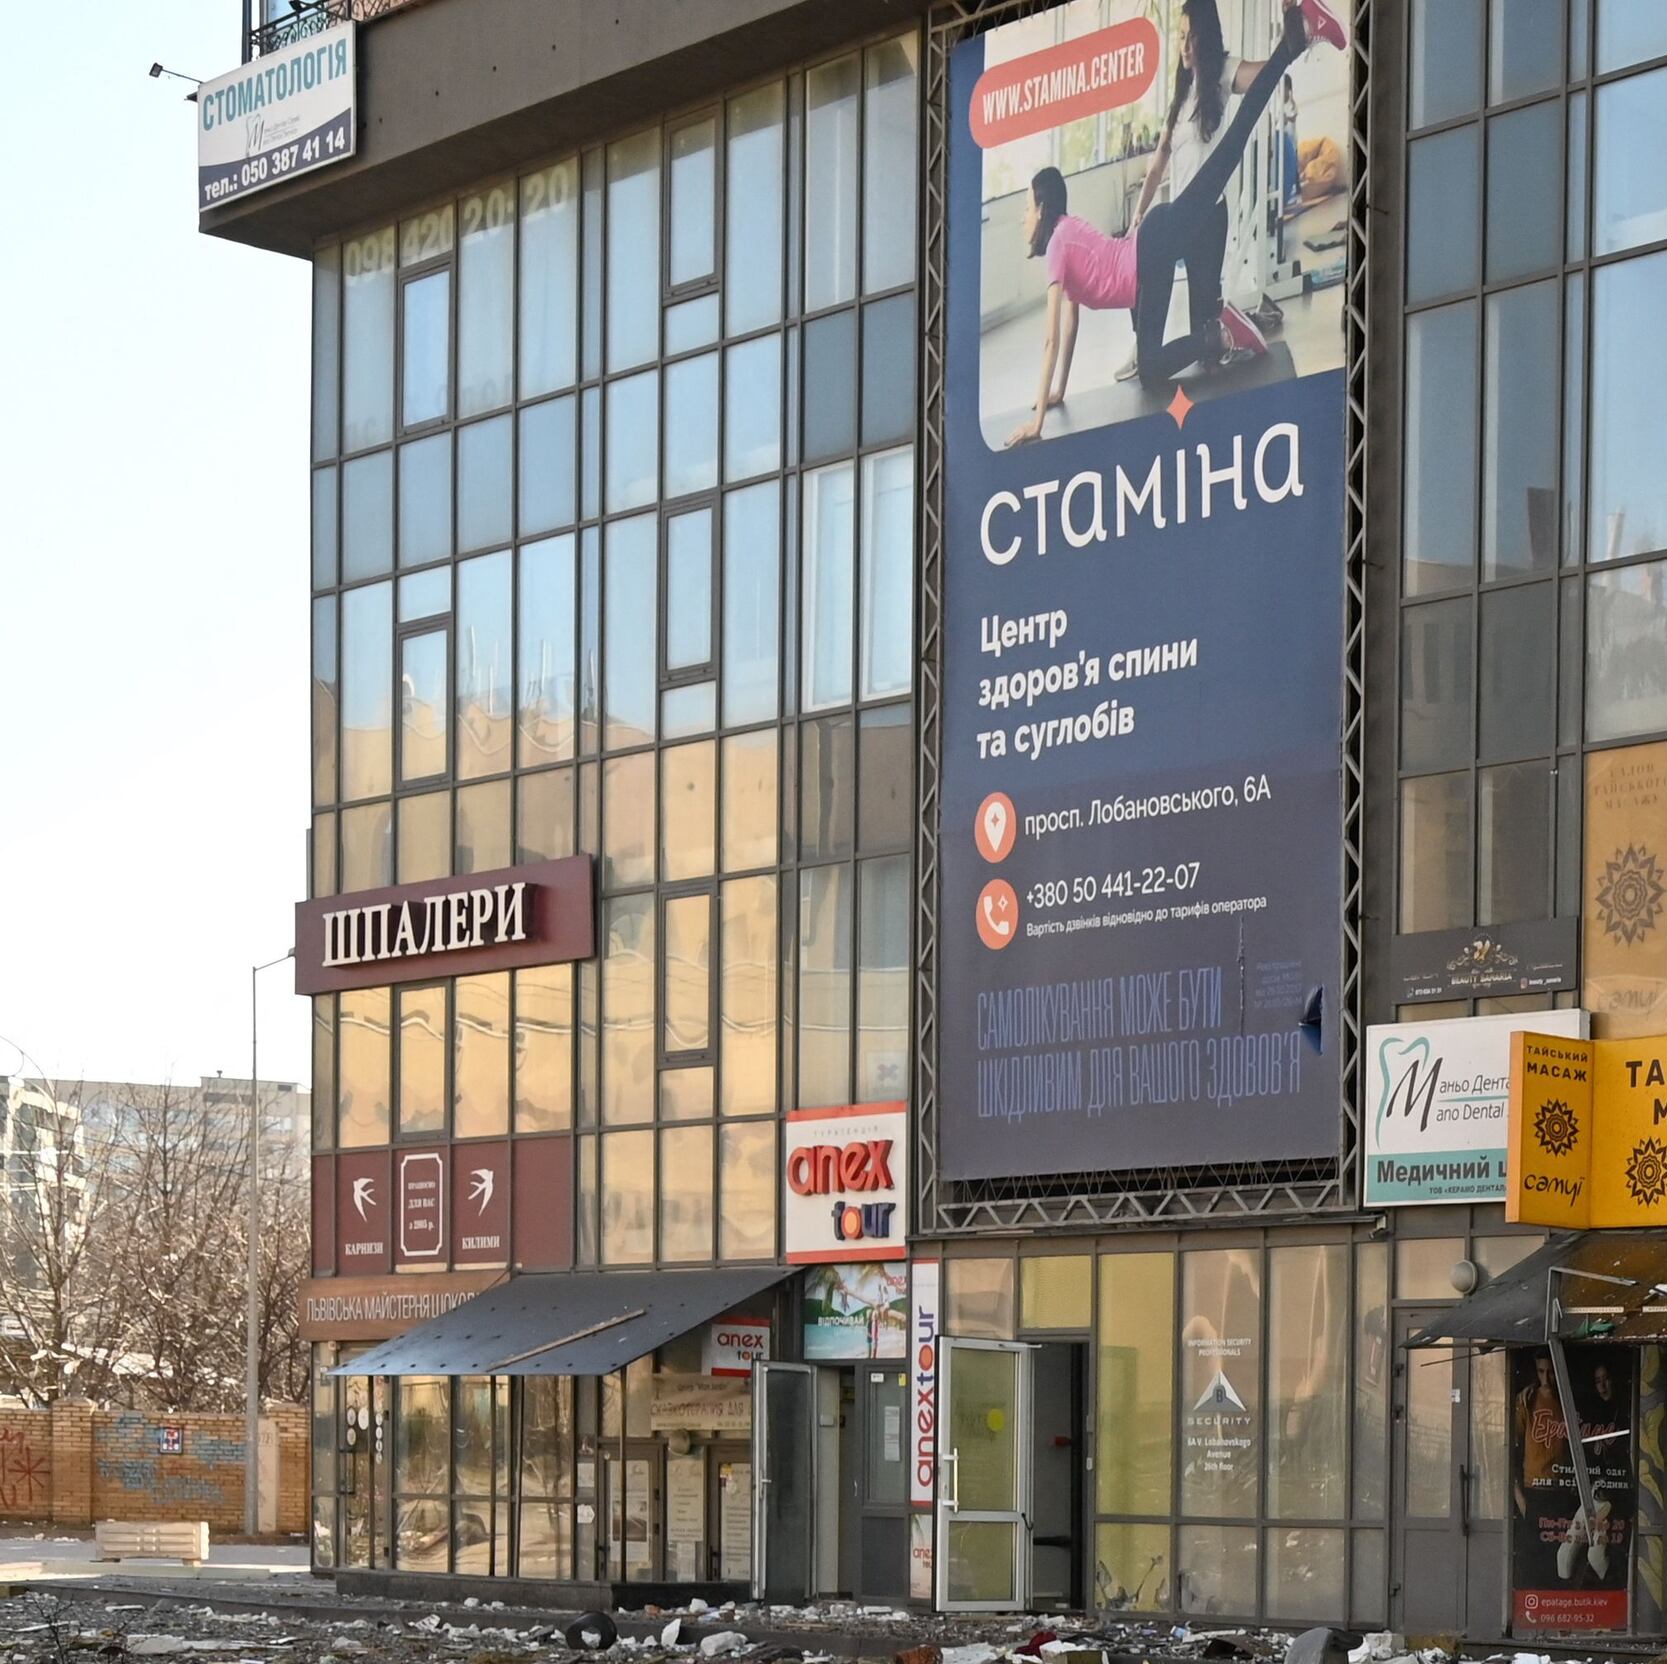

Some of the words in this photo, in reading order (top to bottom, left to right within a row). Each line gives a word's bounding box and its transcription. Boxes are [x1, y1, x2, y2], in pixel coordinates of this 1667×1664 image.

[203, 39, 347, 131] СТОМАТОЛОГІЯ
[982, 42, 1145, 125] WWW.STAMINA.CENTER
[205, 174, 238, 200] тел.:
[241, 157, 267, 186] 050
[271, 145, 299, 175] 387
[302, 136, 320, 162] 41
[326, 127, 345, 153] 14
[980, 609, 1068, 657] Центр
[978, 651, 1099, 710] здоров'я
[1108, 638, 1198, 682] спини
[977, 732, 1006, 760] та
[1014, 699, 1135, 761] суглобів
[1025, 805, 1083, 840] просп.
[1089, 783, 1239, 826] Лобановського,
[1027, 881, 1068, 909] +380
[1073, 876, 1097, 903] 50
[1101, 861, 1200, 898] 441-22-07
[322, 882, 527, 968] ШПАЛЕРИ
[977, 978, 1115, 1051] САМОЛІКУВАННЯ
[1119, 971, 1173, 1037] МОЖЕ
[1178, 966, 1223, 1030] БУТИ
[1526, 1044, 1589, 1064] ТАЙСЬКИЙ
[1527, 1060, 1588, 1084] МАСАЖ
[977, 1050, 1082, 1124] ШКІДЛИВИМ
[1086, 1046, 1124, 1118] ДЛЯ
[1129, 1039, 1201, 1107] ВАШОГО
[1463, 1104, 1504, 1122] Dental
[787, 1139, 895, 1196] anex
[1377, 1155, 1490, 1187] Медичний
[1429, 1186, 1443, 1196] ТОВ
[1523, 1172, 1585, 1209] самуї
[462, 1235, 500, 1250] КИЛИМИ
[831, 1200, 897, 1242] tour
[345, 1242, 384, 1256] КАРНИЗИ
[306, 1295, 363, 1323] ЛЬВІВСЬКА
[365, 1291, 430, 1321] МАЙСТЕРНЯ
[717, 1332, 763, 1349] anex
[737, 1350, 763, 1361] tour
